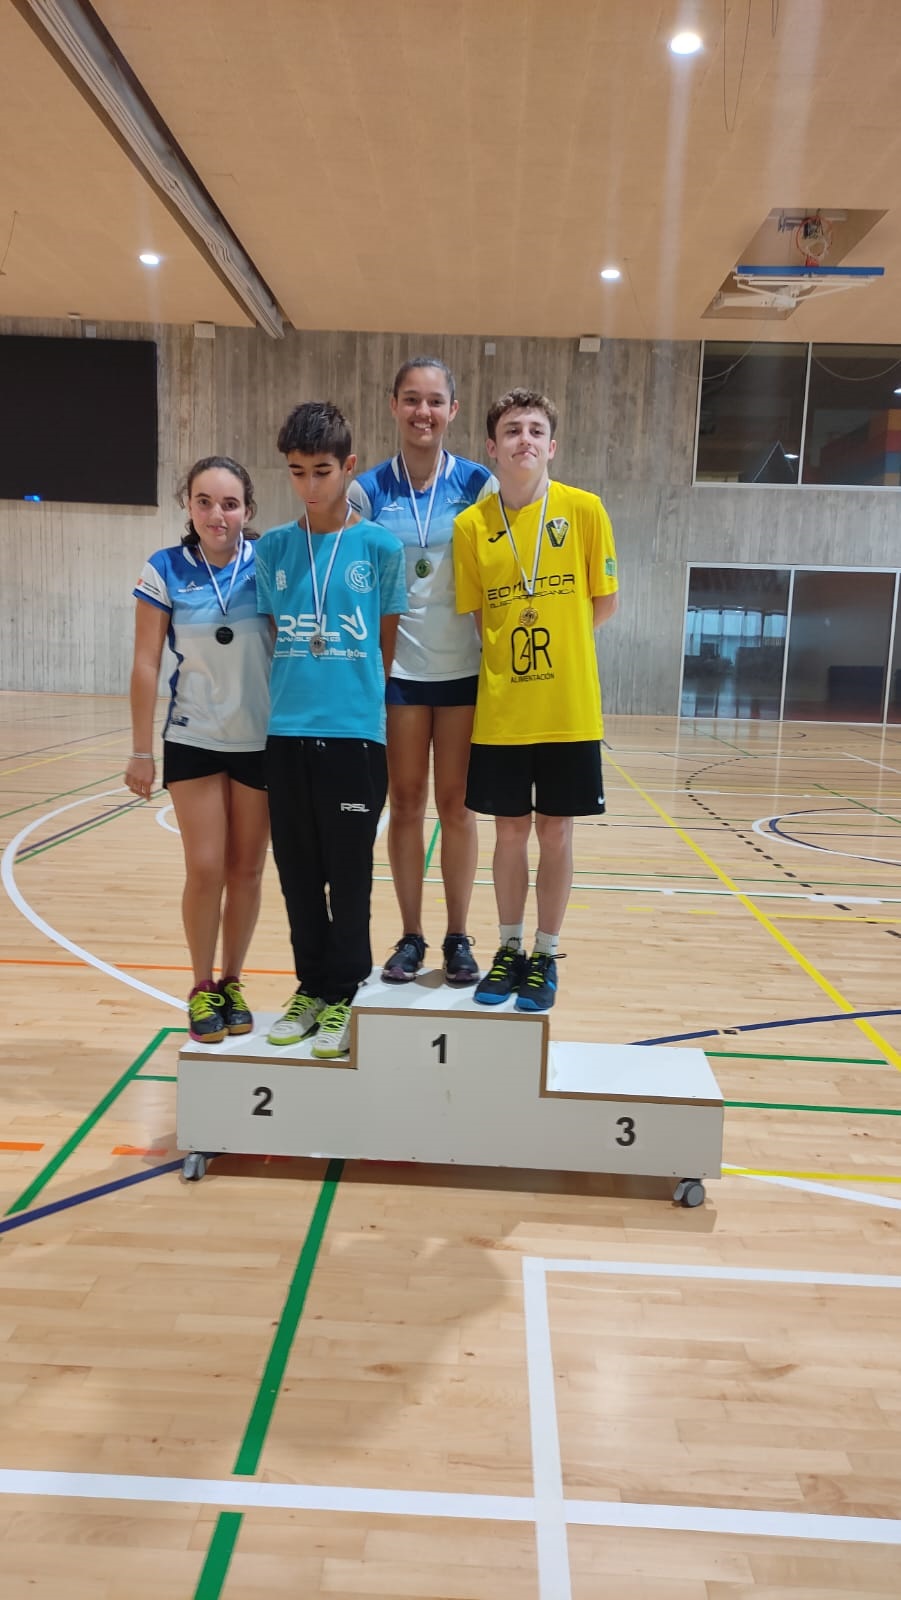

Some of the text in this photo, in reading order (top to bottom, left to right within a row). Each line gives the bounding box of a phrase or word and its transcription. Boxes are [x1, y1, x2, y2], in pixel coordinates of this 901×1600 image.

[278, 613, 341, 637] RSL
[511, 626, 553, 676] CAR
[340, 802, 370, 812] RSL
[431, 1033, 447, 1064] 1
[252, 1086, 273, 1117] 2
[615, 1116, 636, 1147] 3
